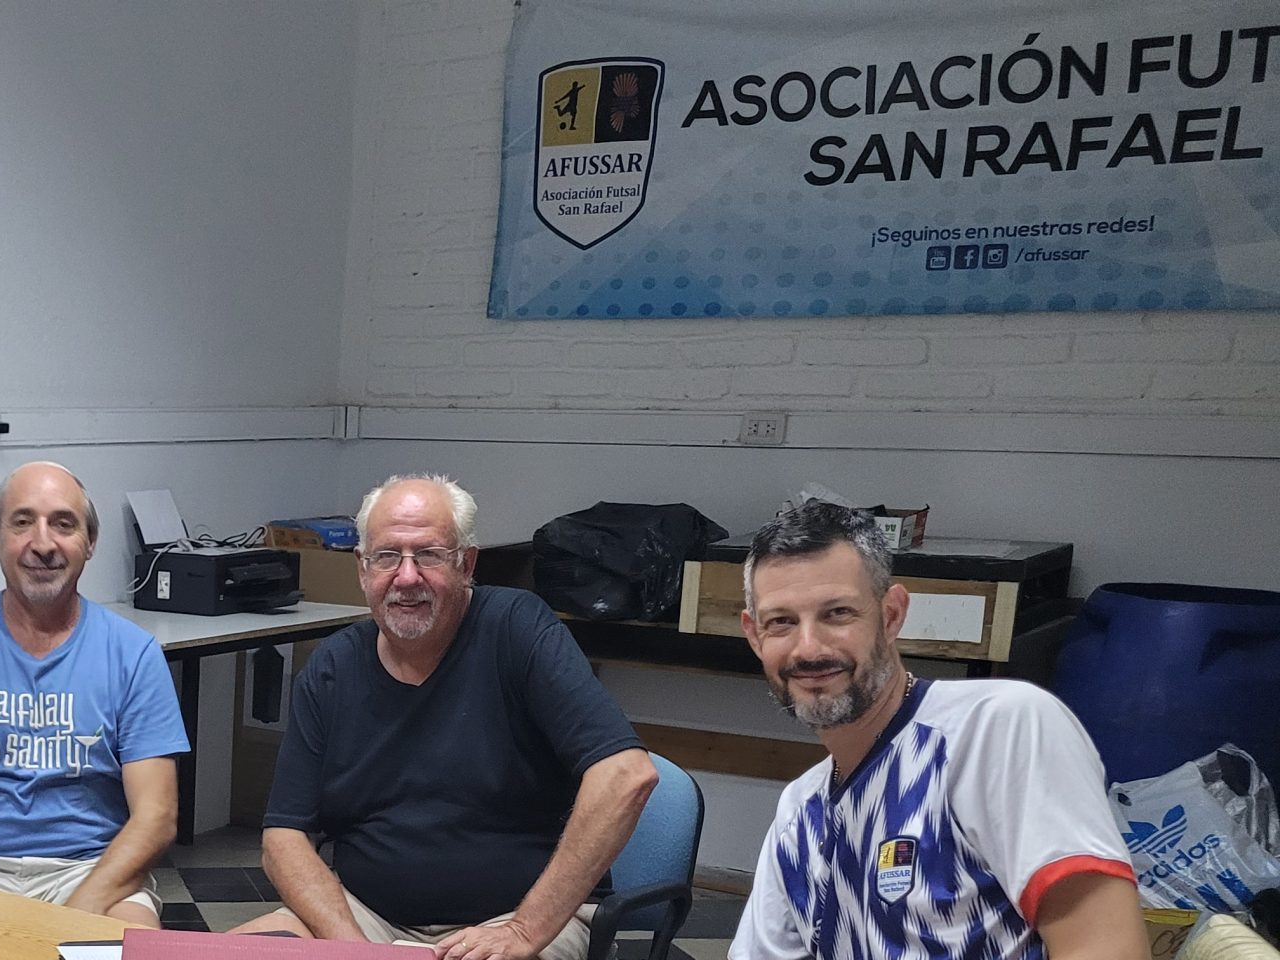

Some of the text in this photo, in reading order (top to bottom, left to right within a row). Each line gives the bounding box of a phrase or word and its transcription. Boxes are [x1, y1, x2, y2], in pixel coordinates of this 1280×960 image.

[681, 25, 1280, 128] ASOCIACIÓN FUT
[803, 105, 1263, 186] SAN RAFAEL
[543, 153, 643, 178] AFUSSAR
[540, 184, 641, 202] Asociación Futsal
[558, 201, 623, 216] San Rafael
[871, 215, 1156, 247] ¡Seguinos en nuestras redes!
[1014, 246, 1090, 263] /afussar
[1137, 833, 1221, 888] adidas
